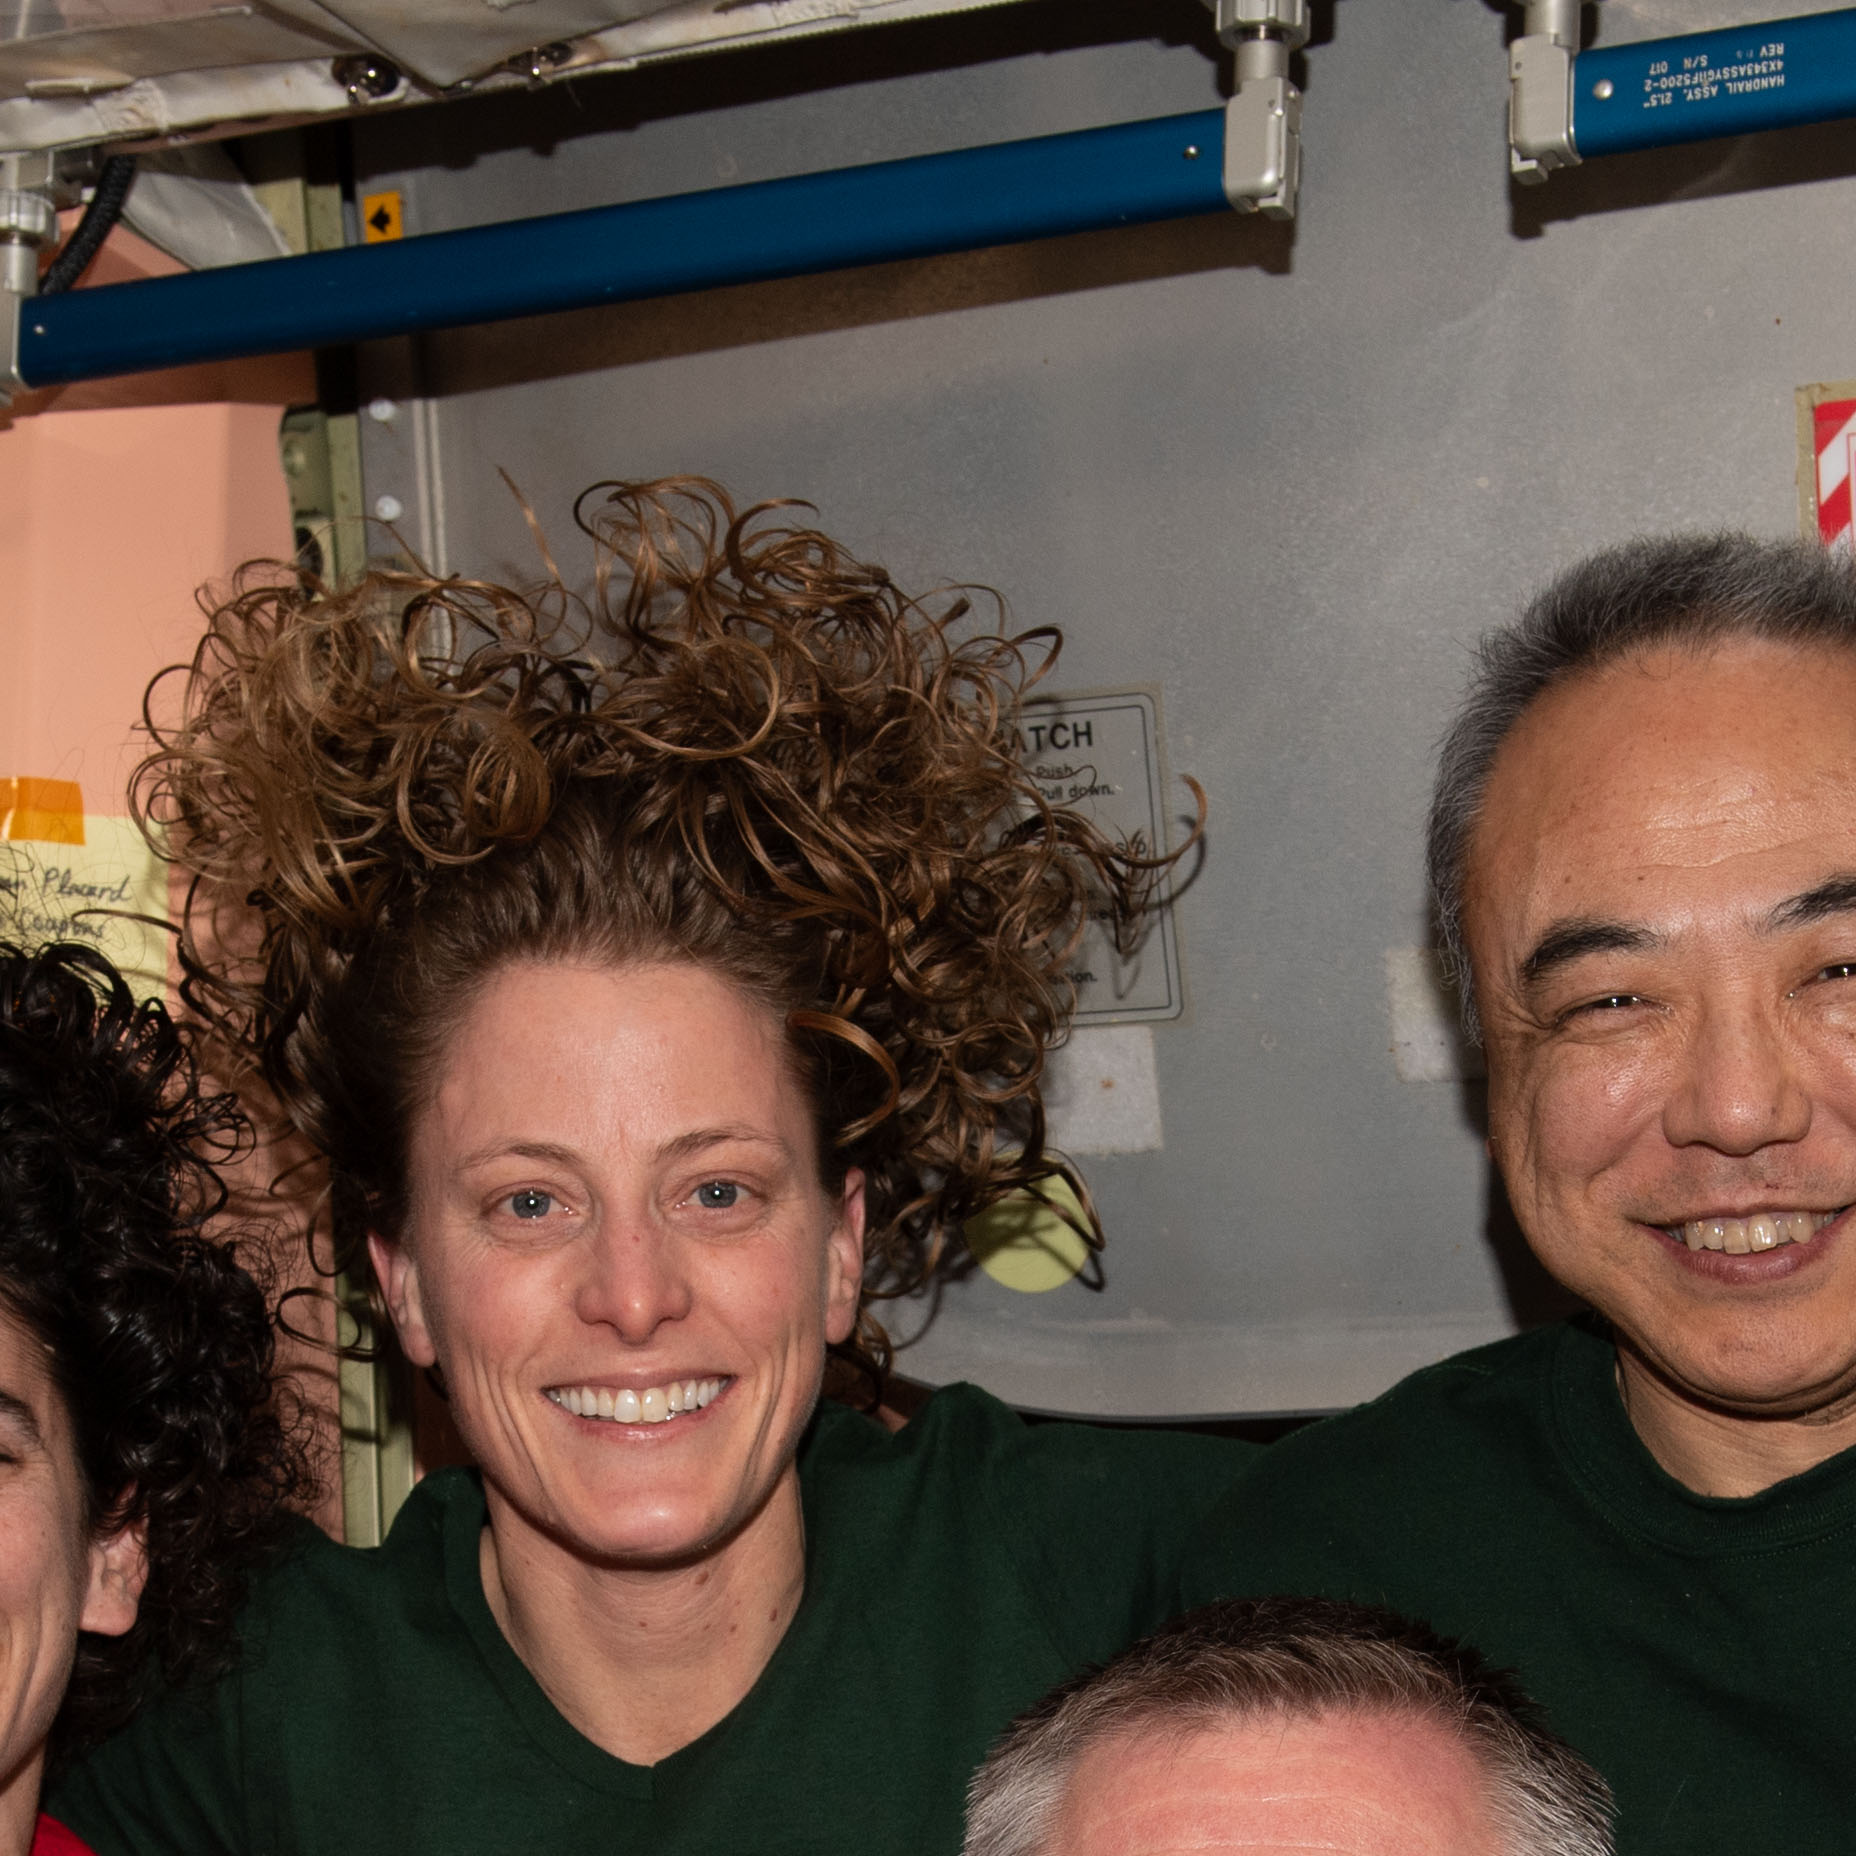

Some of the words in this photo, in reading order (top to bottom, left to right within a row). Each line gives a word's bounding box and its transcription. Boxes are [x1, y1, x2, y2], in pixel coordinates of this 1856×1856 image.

[1759, 42, 1785, 57] REV
[1682, 54, 1709, 70] S/N
[1726, 73, 1785, 95] HANDRAIL
[44, 866, 132, 904] Placard
